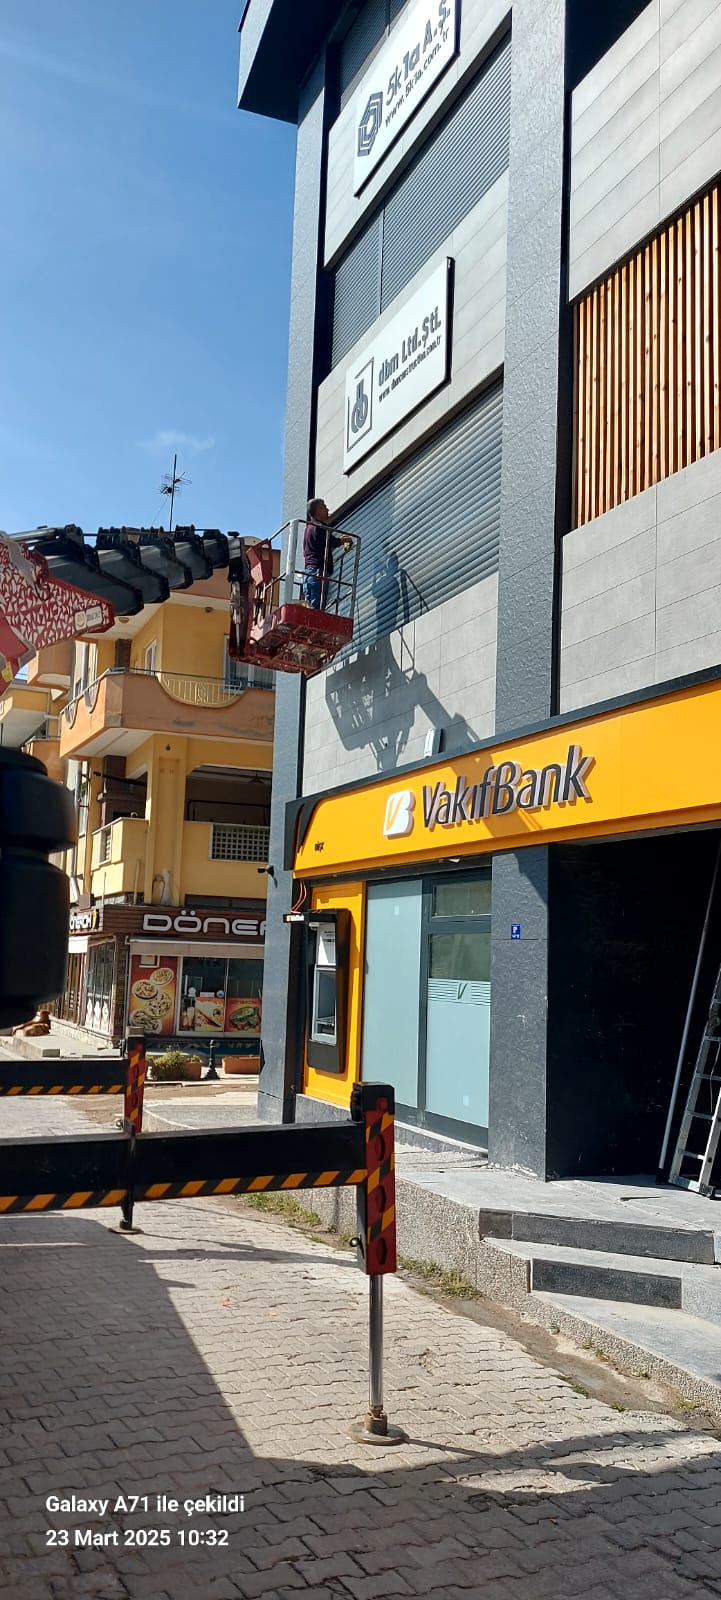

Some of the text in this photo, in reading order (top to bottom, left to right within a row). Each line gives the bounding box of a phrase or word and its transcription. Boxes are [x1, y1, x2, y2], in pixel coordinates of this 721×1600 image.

[378, 352, 399, 387] dbm
[422, 744, 594, 831] VakıfBank
[142, 910, 267, 936] DÖNE
